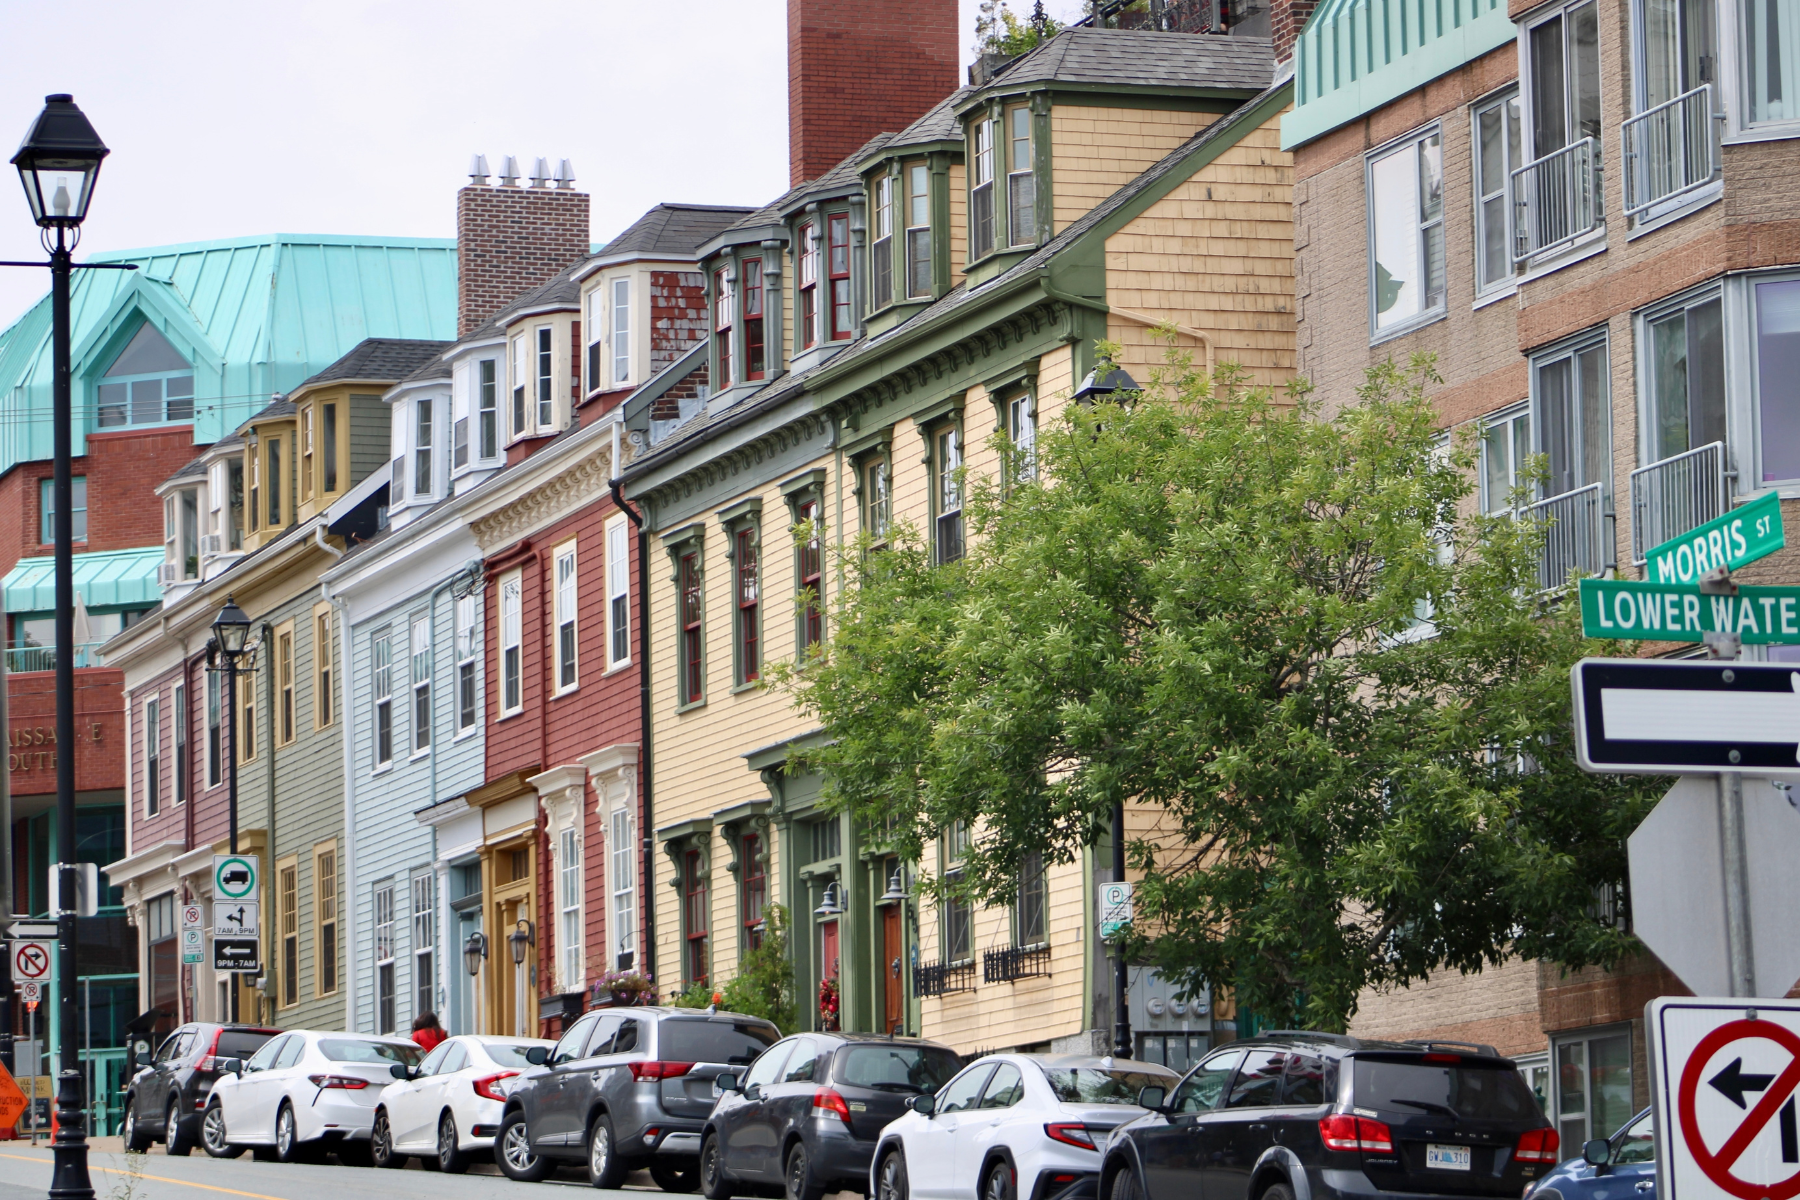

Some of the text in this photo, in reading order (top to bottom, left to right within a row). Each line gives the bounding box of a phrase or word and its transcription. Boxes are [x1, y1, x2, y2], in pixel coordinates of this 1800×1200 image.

[1656, 515, 1770, 584] MORRIS ST
[1597, 590, 1701, 632] LOWER
[217, 959, 234, 967] 9PM
[1453, 1152, 1469, 1164] 310
